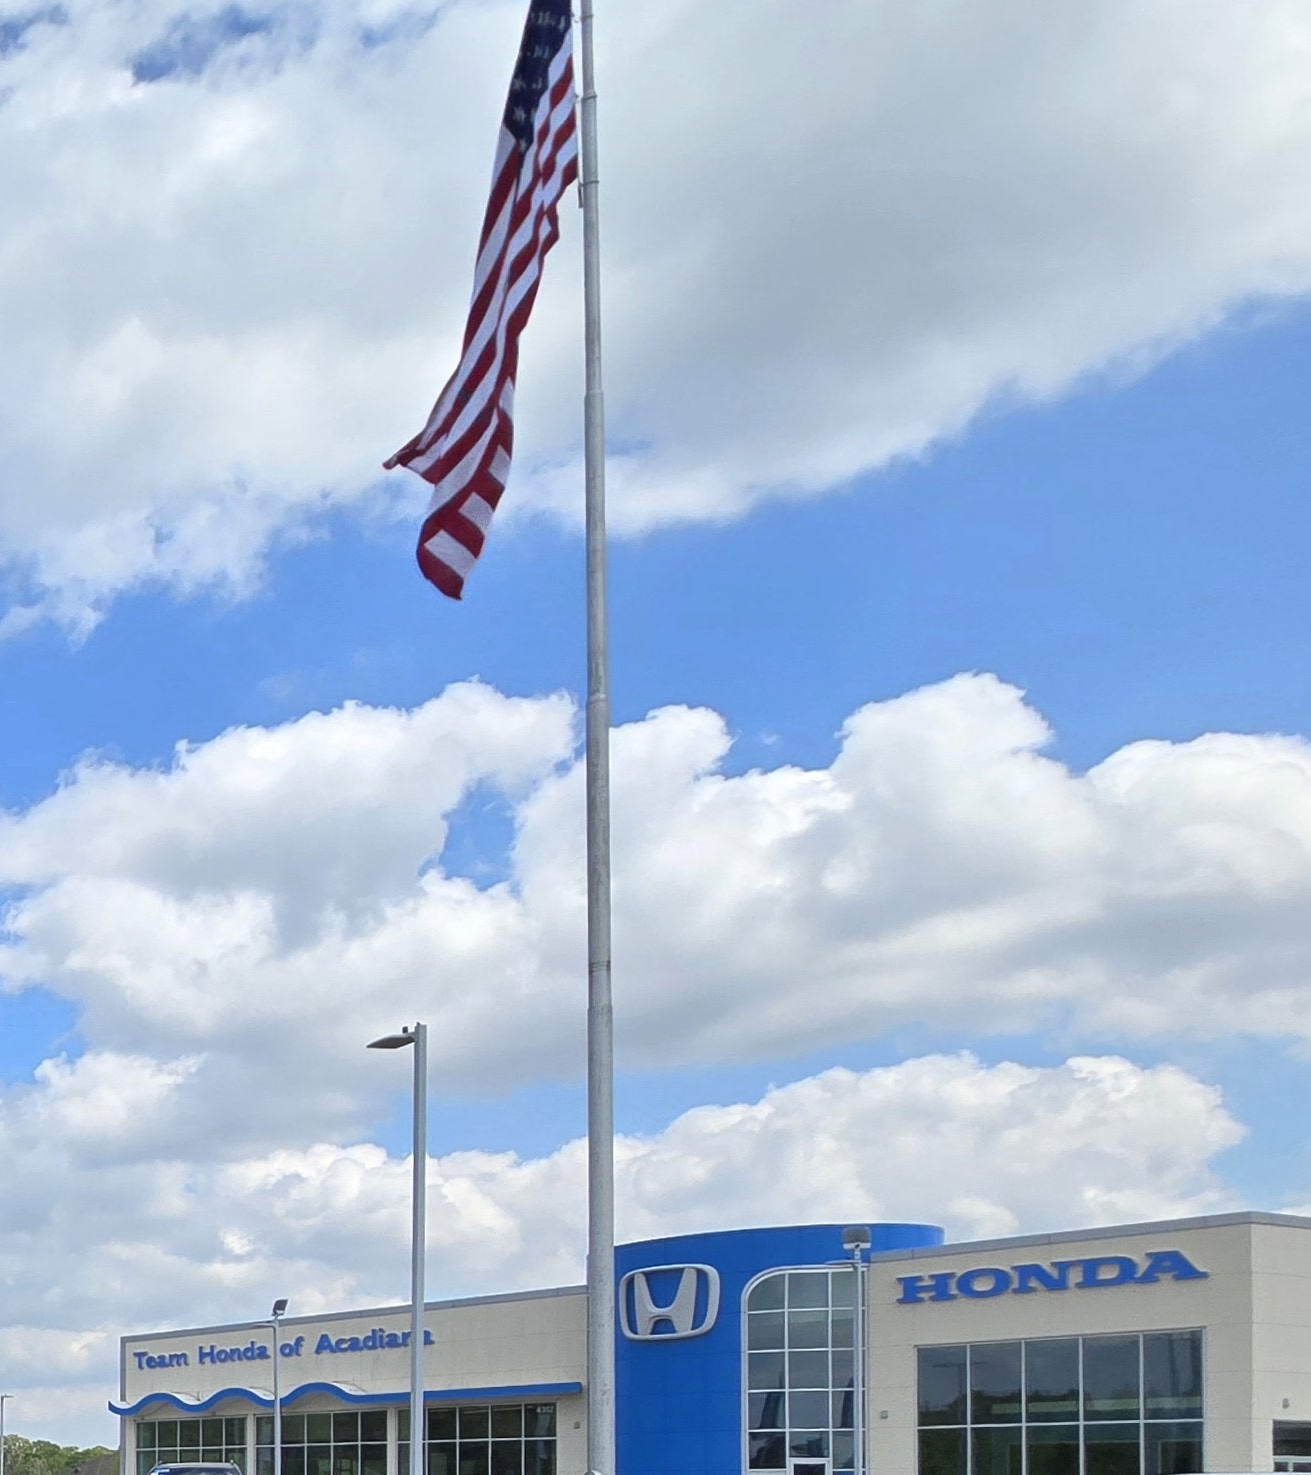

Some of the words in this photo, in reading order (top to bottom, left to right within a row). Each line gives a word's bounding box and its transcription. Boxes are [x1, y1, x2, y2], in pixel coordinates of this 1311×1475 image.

[895, 1249, 1210, 1305] HONDA
[132, 1350, 190, 1371] Team
[197, 1340, 272, 1366] Honda
[279, 1335, 306, 1358] of
